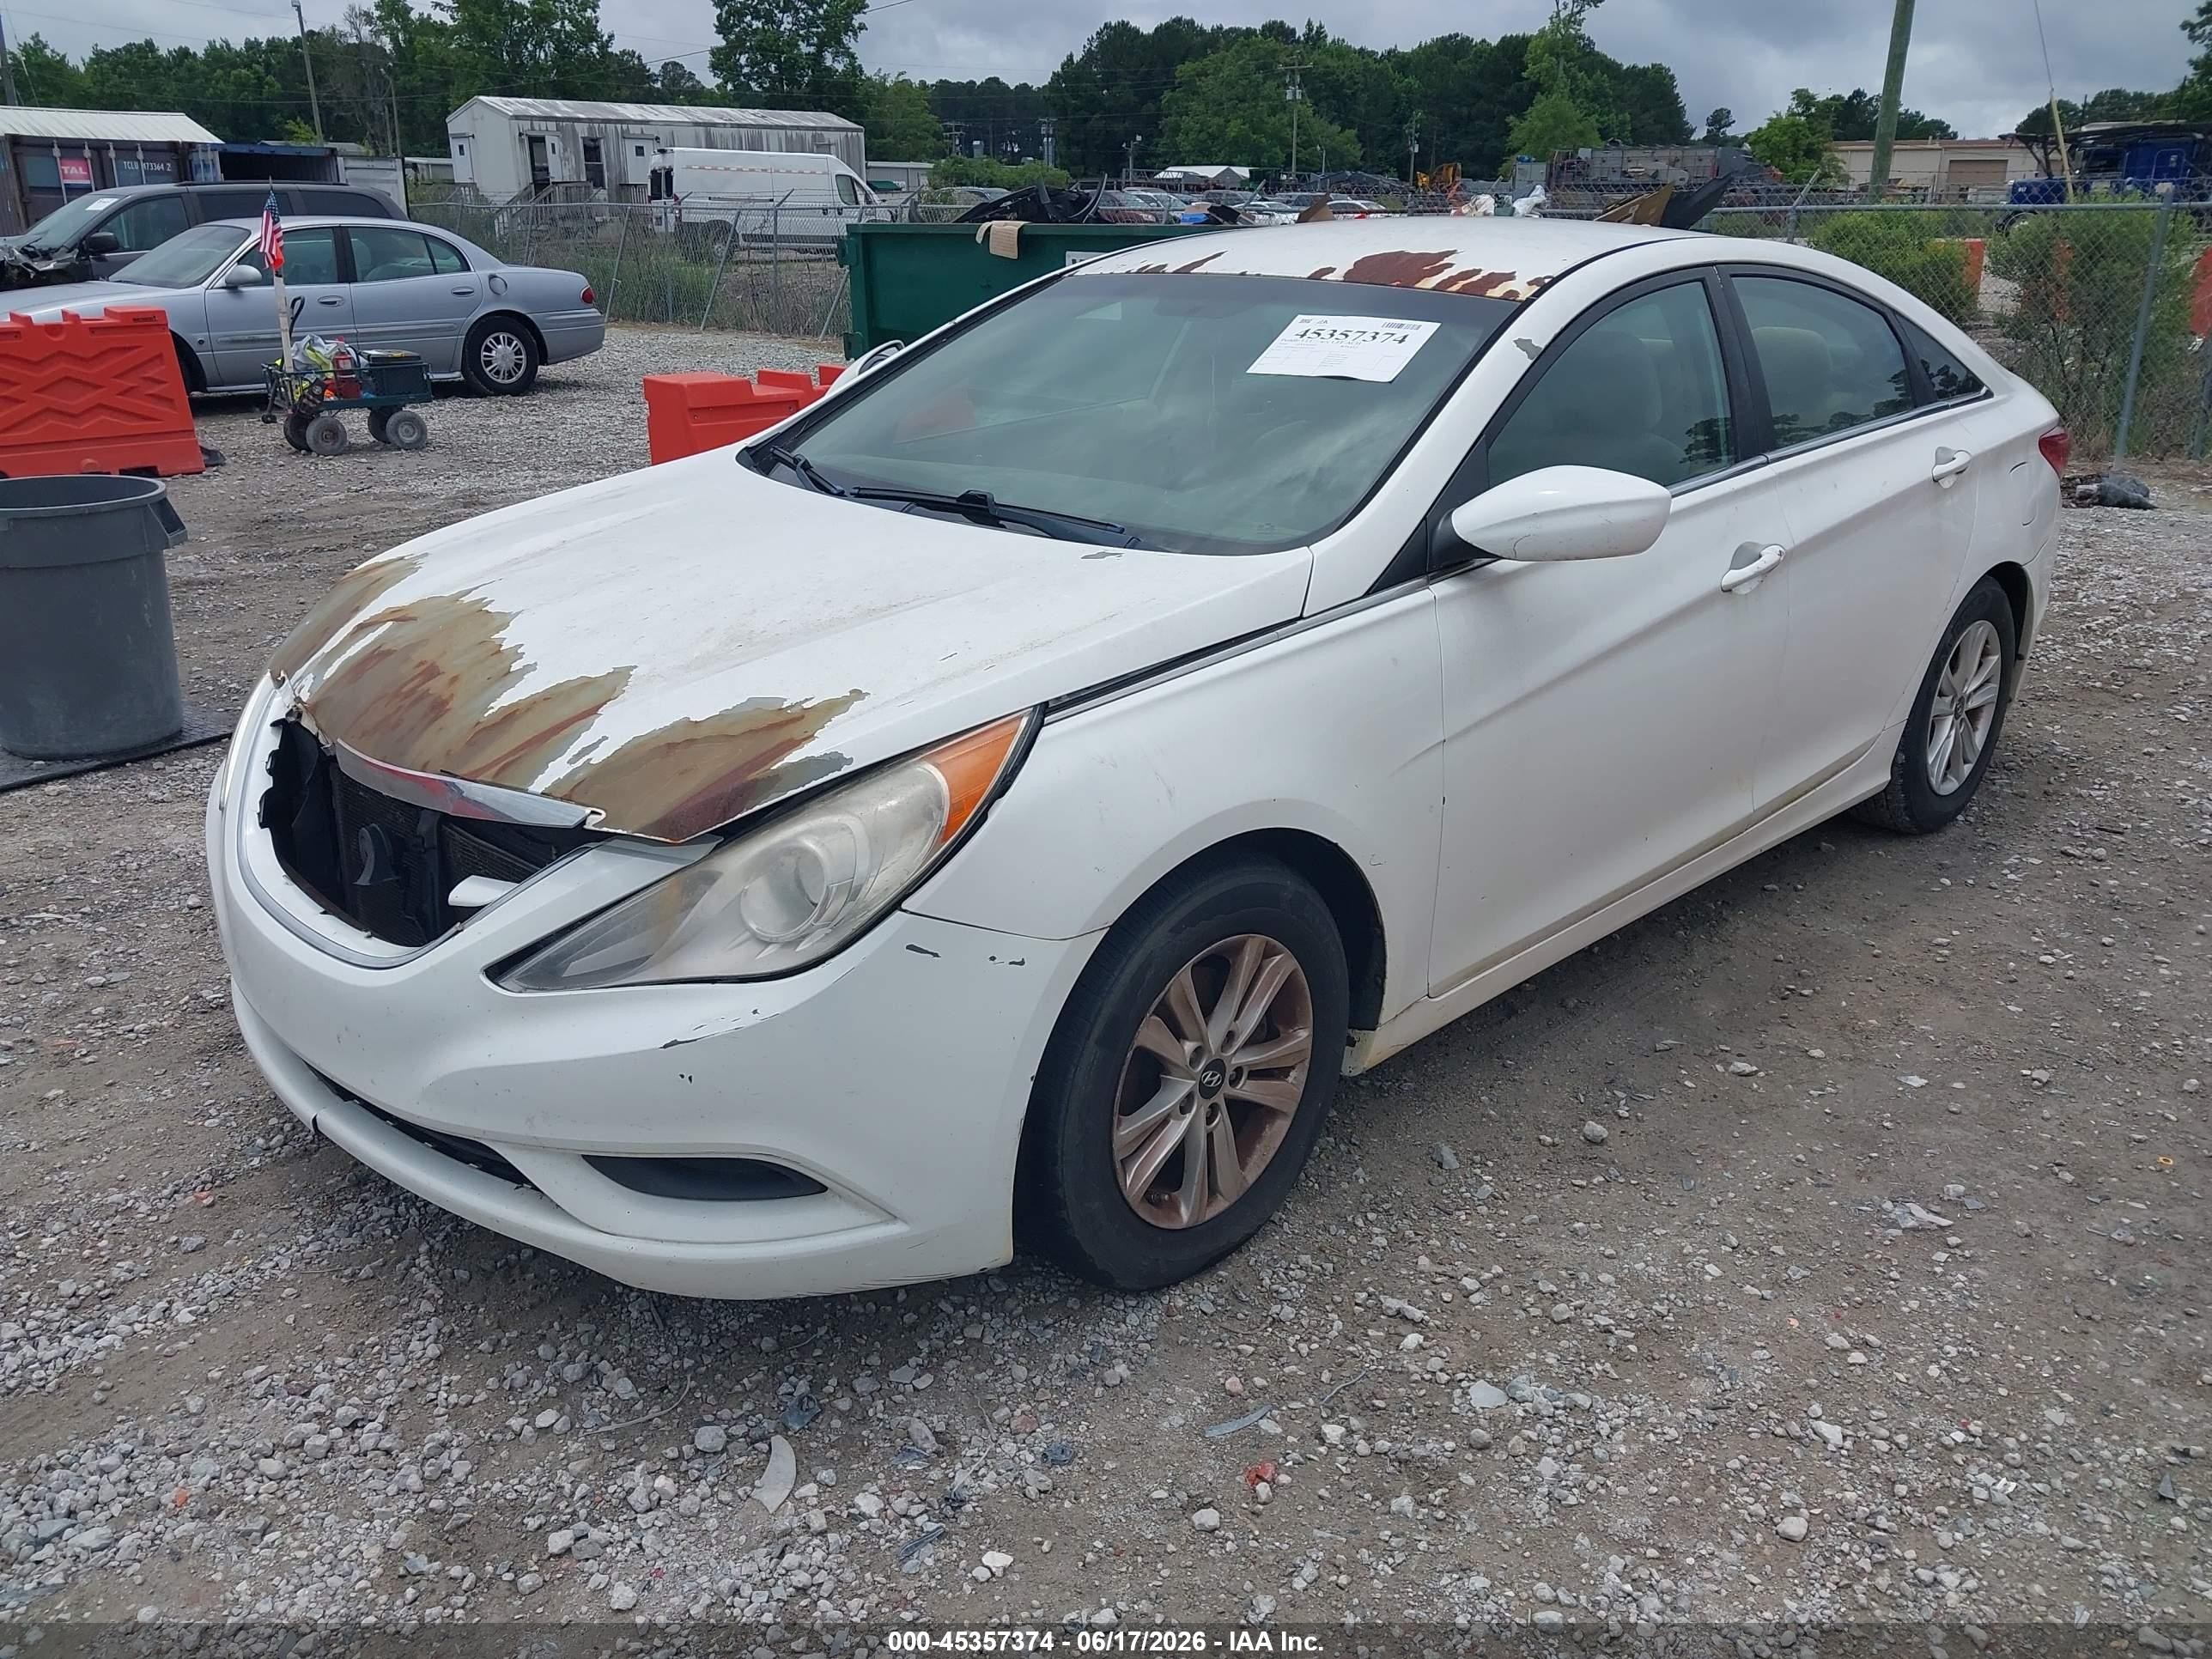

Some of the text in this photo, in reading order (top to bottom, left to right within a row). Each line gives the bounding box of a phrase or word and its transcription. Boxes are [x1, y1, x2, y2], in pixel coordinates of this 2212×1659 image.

[62, 166, 88, 175] TAL
[123, 161, 139, 170] TCLU
[166, 162, 172, 172] 2
[1295, 328, 1409, 344] 45357374
